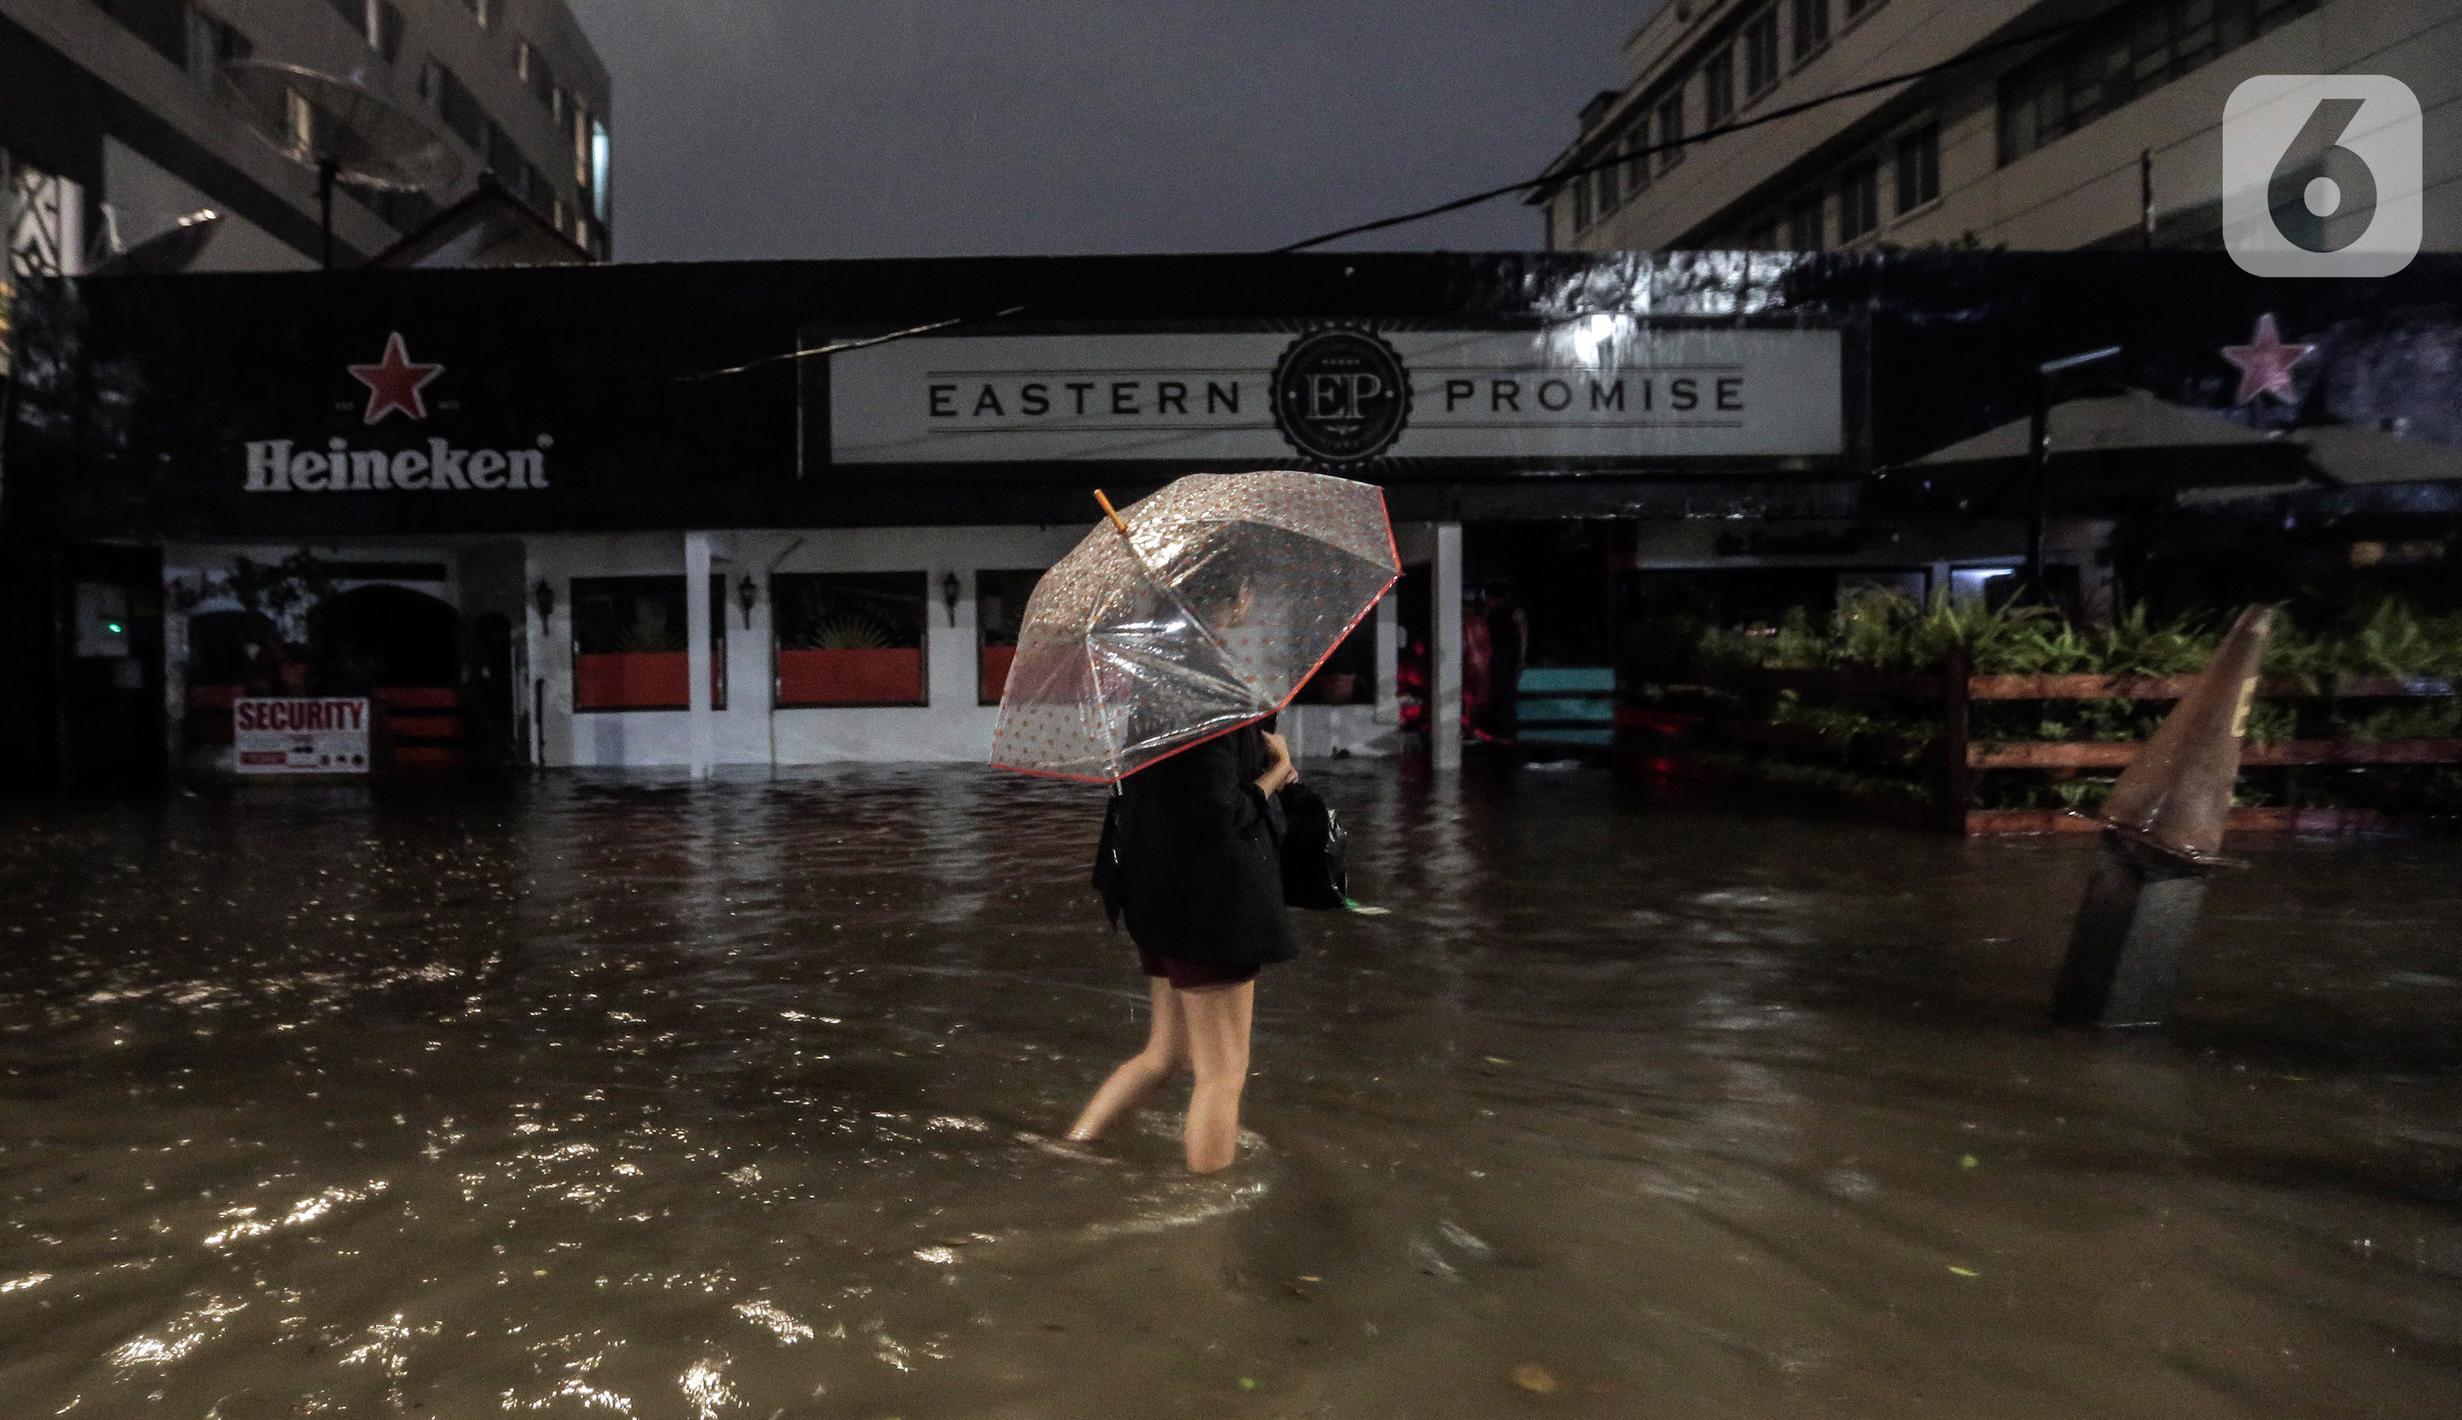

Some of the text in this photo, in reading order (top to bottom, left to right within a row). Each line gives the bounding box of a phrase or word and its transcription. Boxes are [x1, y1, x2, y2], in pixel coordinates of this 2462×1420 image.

[929, 378, 1744, 417] EASTERN PROMISE
[1304, 373, 1382, 419] EP
[244, 436, 550, 491] Heineken
[239, 702, 364, 730] SECURITY
